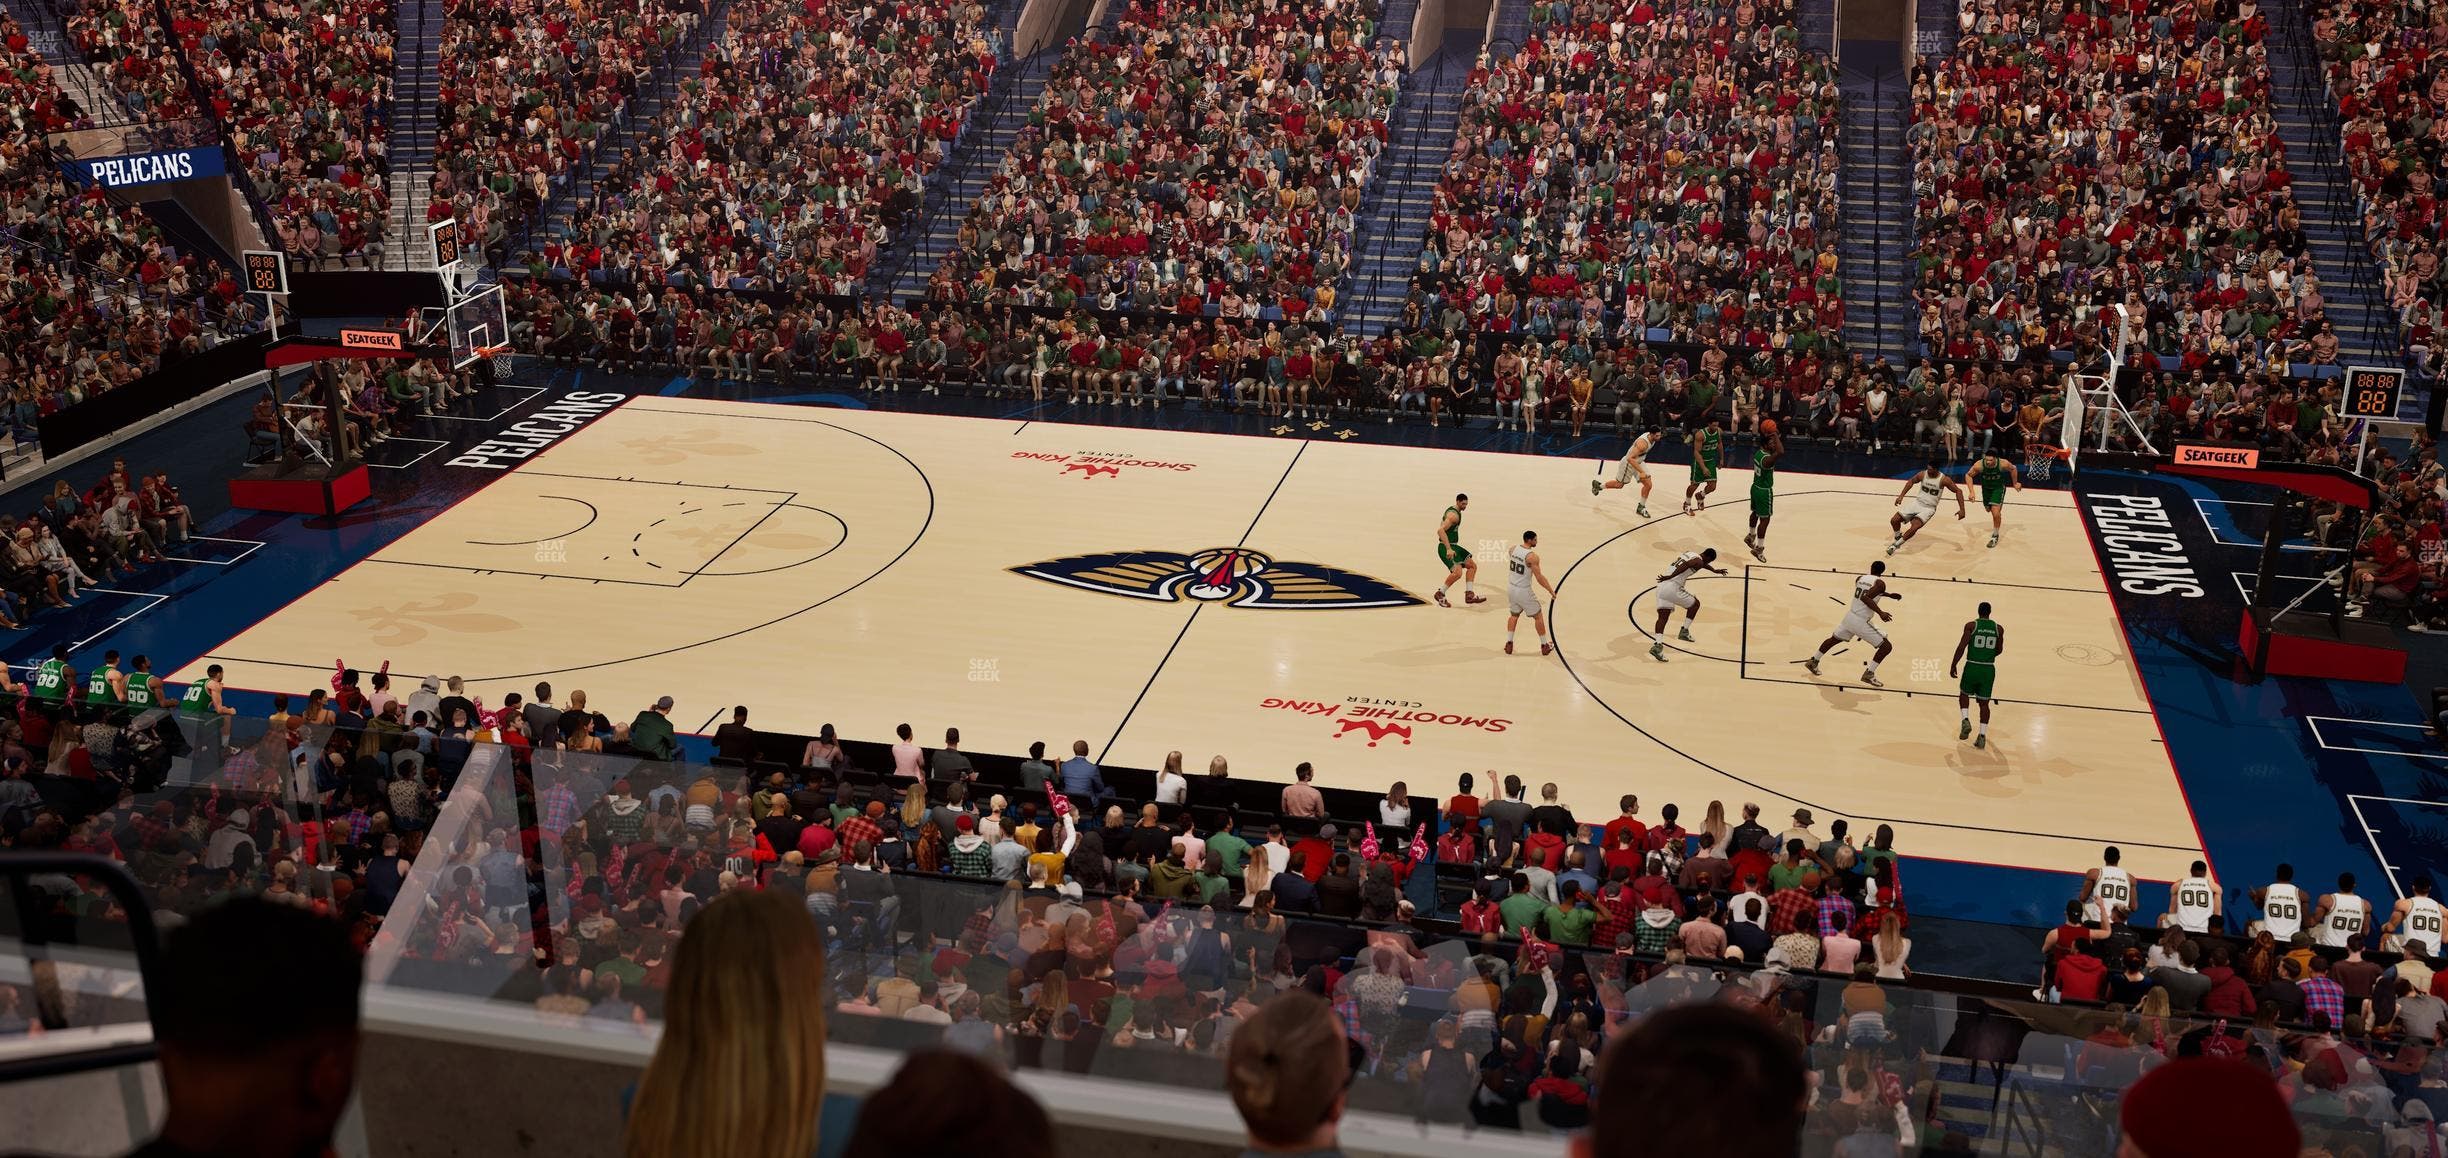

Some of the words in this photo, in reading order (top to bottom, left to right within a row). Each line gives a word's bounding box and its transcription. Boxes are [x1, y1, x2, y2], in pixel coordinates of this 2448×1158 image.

[91, 152, 193, 186] PELICANS
[347, 333, 395, 347] SEATGEEK
[2358, 391, 2387, 413] 88
[444, 391, 626, 470] PELICANS
[1077, 450, 1133, 458] CENTER
[2184, 449, 2248, 465] SEATGEEK
[1075, 456, 1197, 472] SMOOTHIE
[2087, 494, 2205, 598] PELICANS
[1509, 559, 1525, 575] 00
[1974, 635, 1996, 649] 00
[37, 673, 59, 688] 00
[128, 690, 148, 703] 00
[1347, 696, 1422, 708] CENTER
[1347, 706, 1513, 732] SMOOTHIE
[2101, 884, 2127, 901] 00
[2181, 890, 2208, 907] 00
[2268, 903, 2297, 919] 00
[2332, 916, 2361, 931] 00
[2412, 915, 2440, 932] 00
